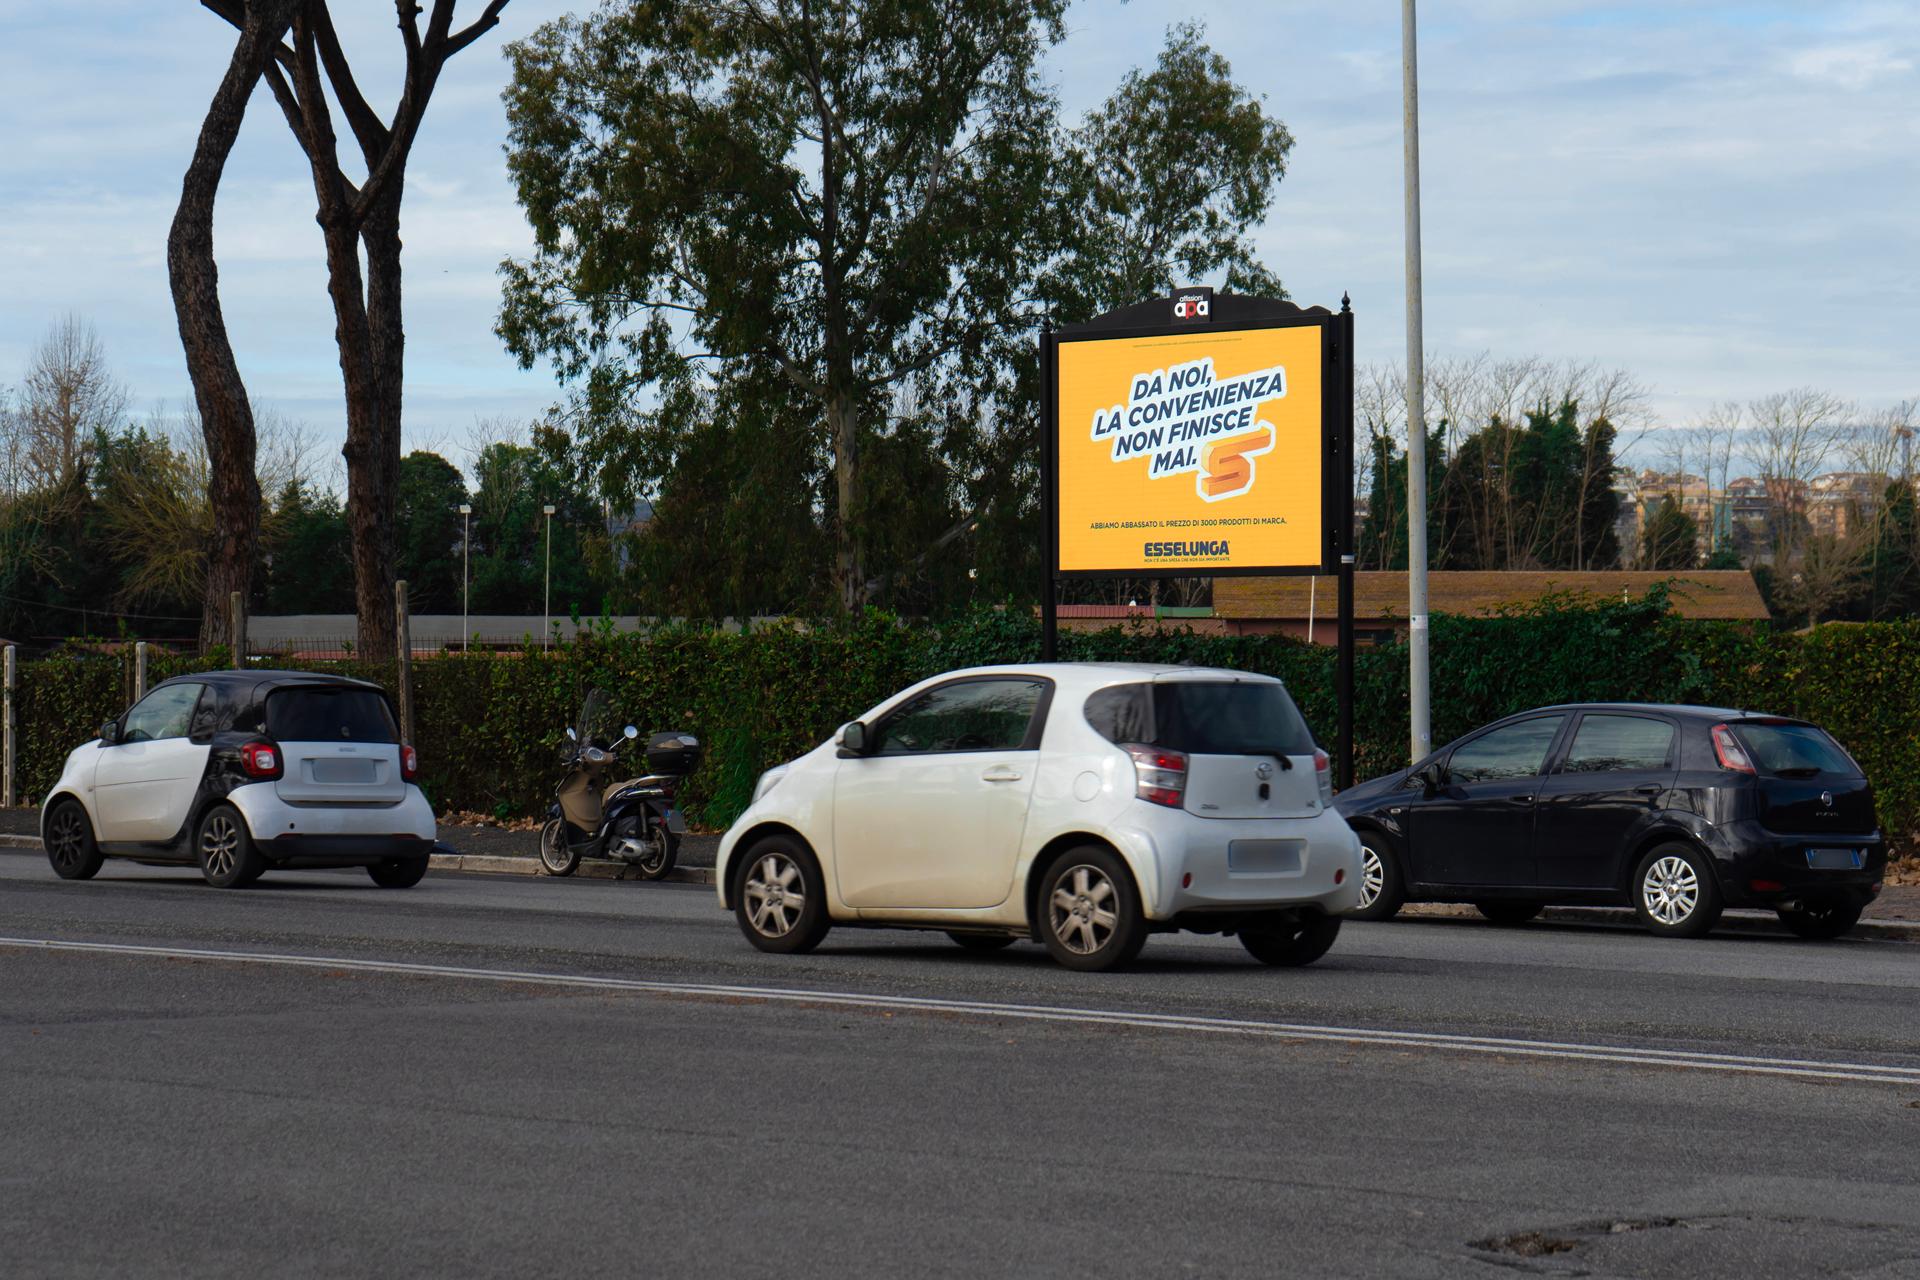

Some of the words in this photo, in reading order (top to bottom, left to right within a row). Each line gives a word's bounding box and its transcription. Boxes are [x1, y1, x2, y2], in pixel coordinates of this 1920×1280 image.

[1174, 300, 1209, 320] apa
[1133, 375, 1162, 401] DA
[1168, 364, 1212, 392] NOI,
[1095, 411, 1122, 436] LA
[1128, 372, 1282, 427] CONVENIENZA
[1115, 426, 1164, 457] NON
[1168, 406, 1253, 444] FINISCE
[1153, 446, 1197, 474] MAI.
[1120, 520, 1158, 528] ABBASSATO
[1159, 520, 1165, 528] IL
[1166, 519, 1191, 527] PREZZO
[1219, 518, 1251, 526] PRODOTTI
[1252, 517, 1260, 525] DI
[1261, 517, 1287, 525] MARCA.
[1144, 540, 1229, 557] ESSELUNGA
